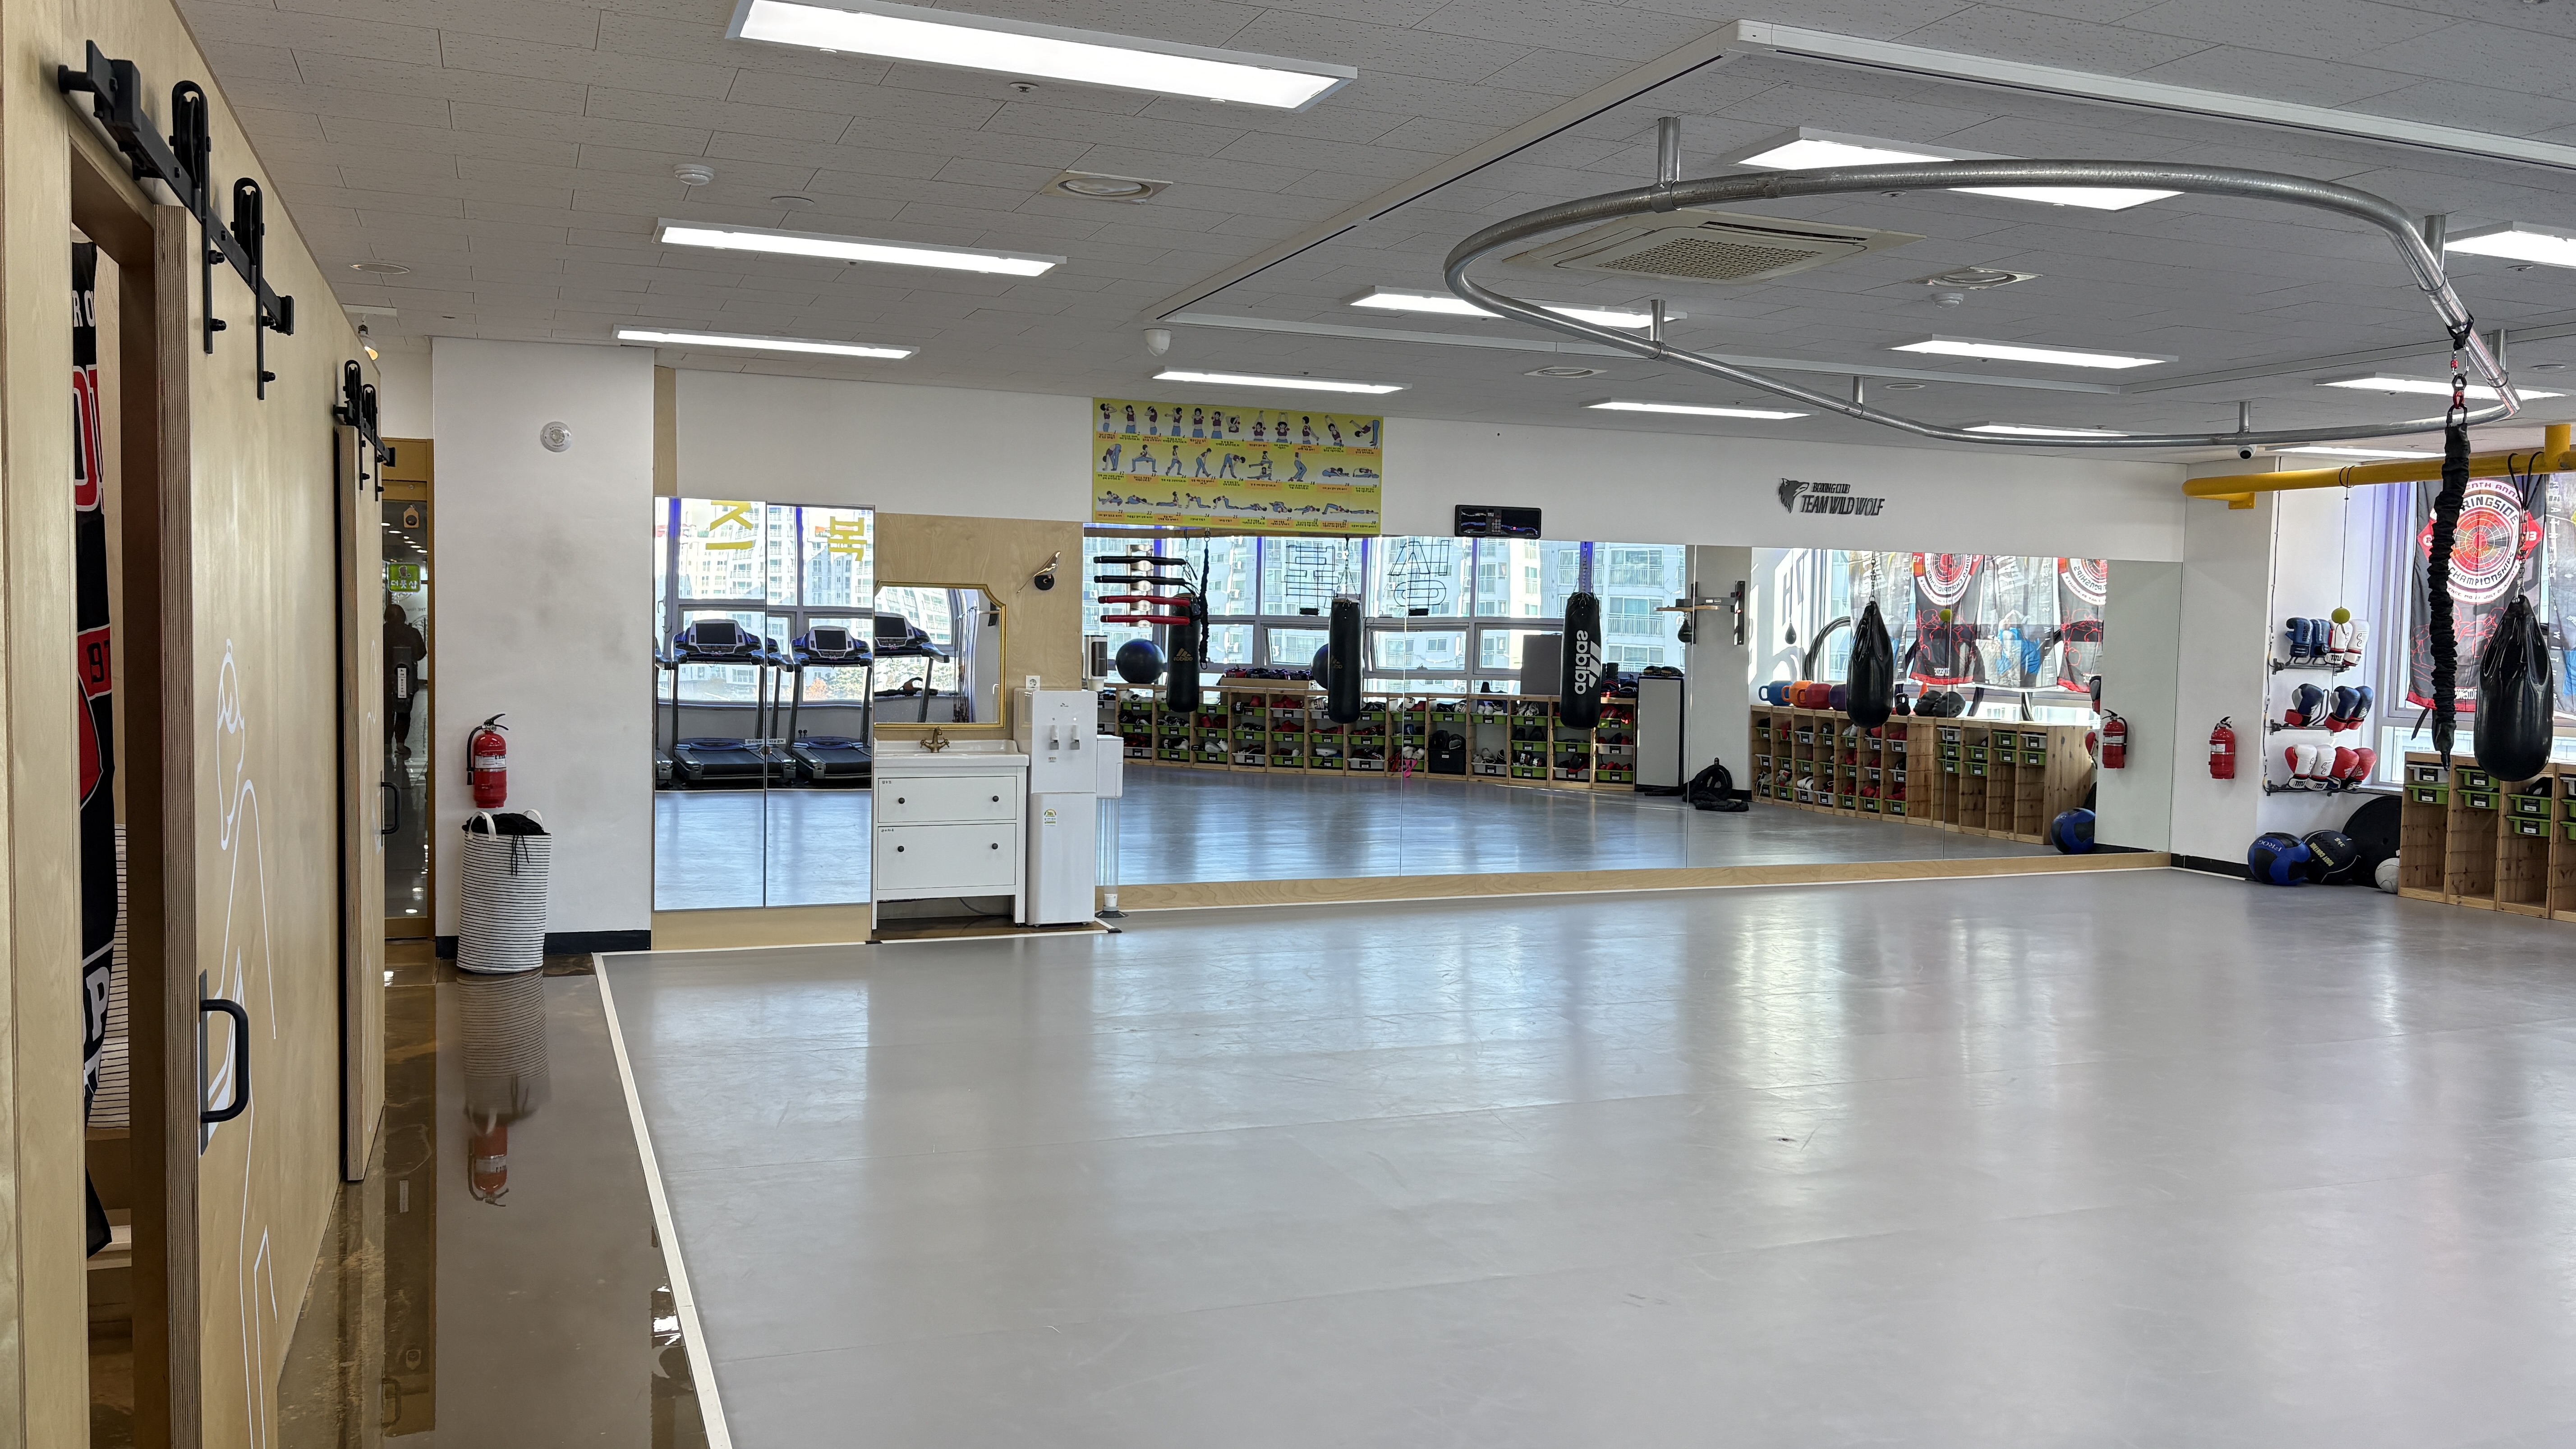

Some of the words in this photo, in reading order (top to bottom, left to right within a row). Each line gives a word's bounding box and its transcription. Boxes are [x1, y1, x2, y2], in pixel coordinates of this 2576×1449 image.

[1812, 483, 1836, 493] BOXING
[1800, 495, 1828, 513] TEAM
[1829, 496, 1855, 515] WILD
[1855, 497, 1885, 515] WOLF
[2461, 496, 2518, 525] RINGSIDE
[2450, 551, 2514, 585] CHAMPIONSHIPS
[2258, 839, 2282, 852] FROG
